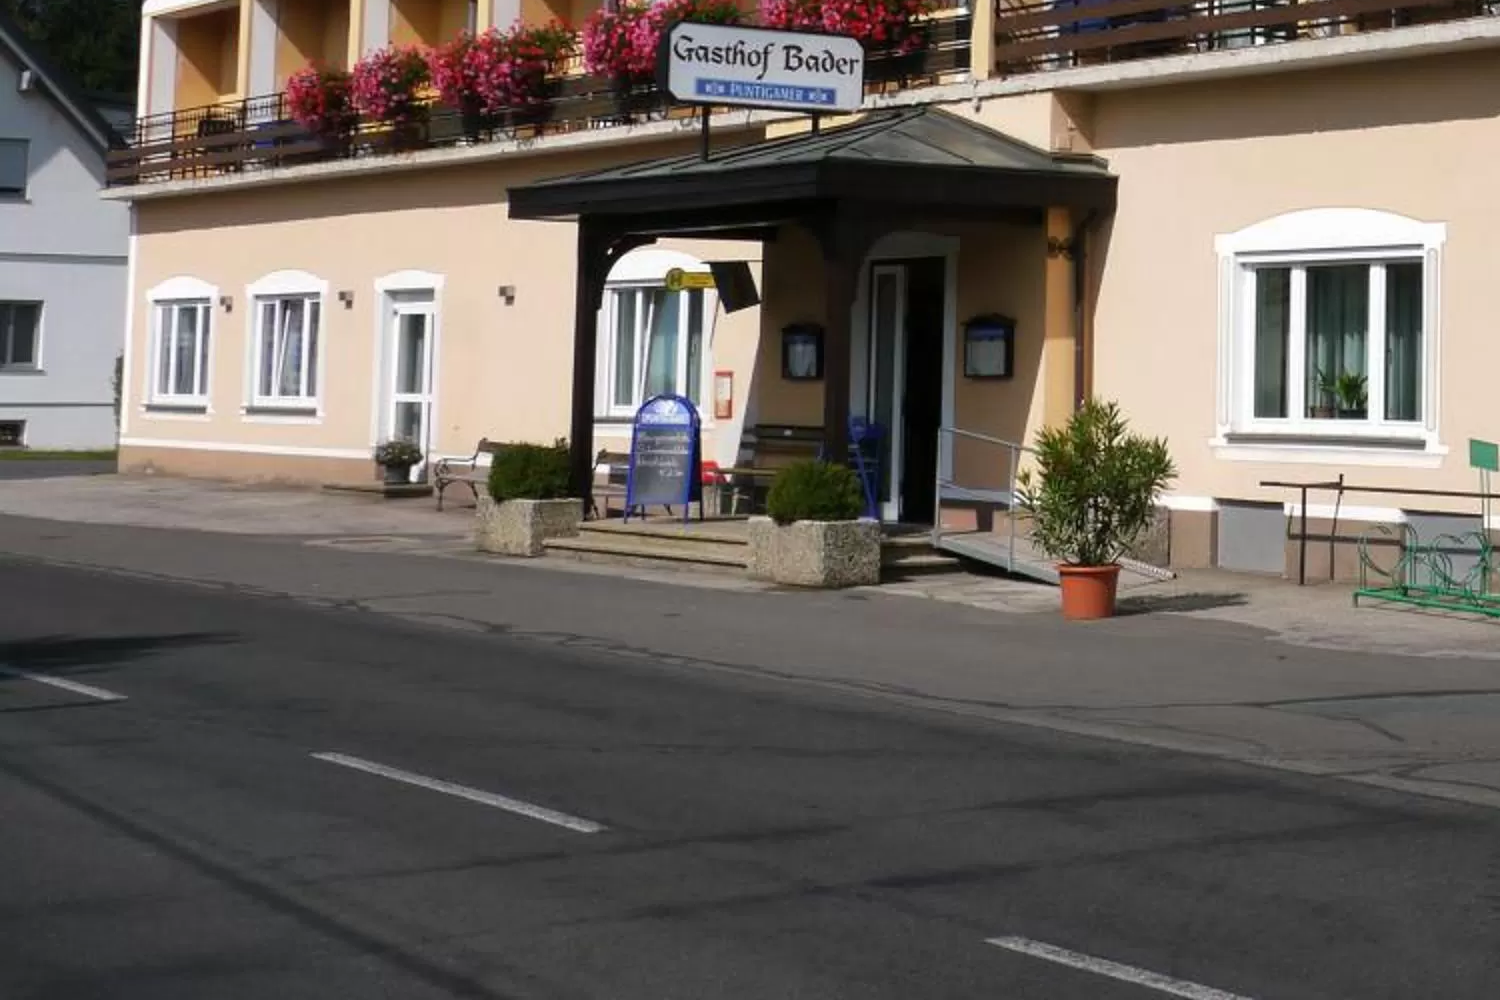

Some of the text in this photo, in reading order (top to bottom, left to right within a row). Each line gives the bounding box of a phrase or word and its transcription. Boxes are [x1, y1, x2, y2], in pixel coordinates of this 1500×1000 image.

[673, 35, 861, 80] Gasthof Bader
[729, 83, 803, 101] PUNTIGAMER
